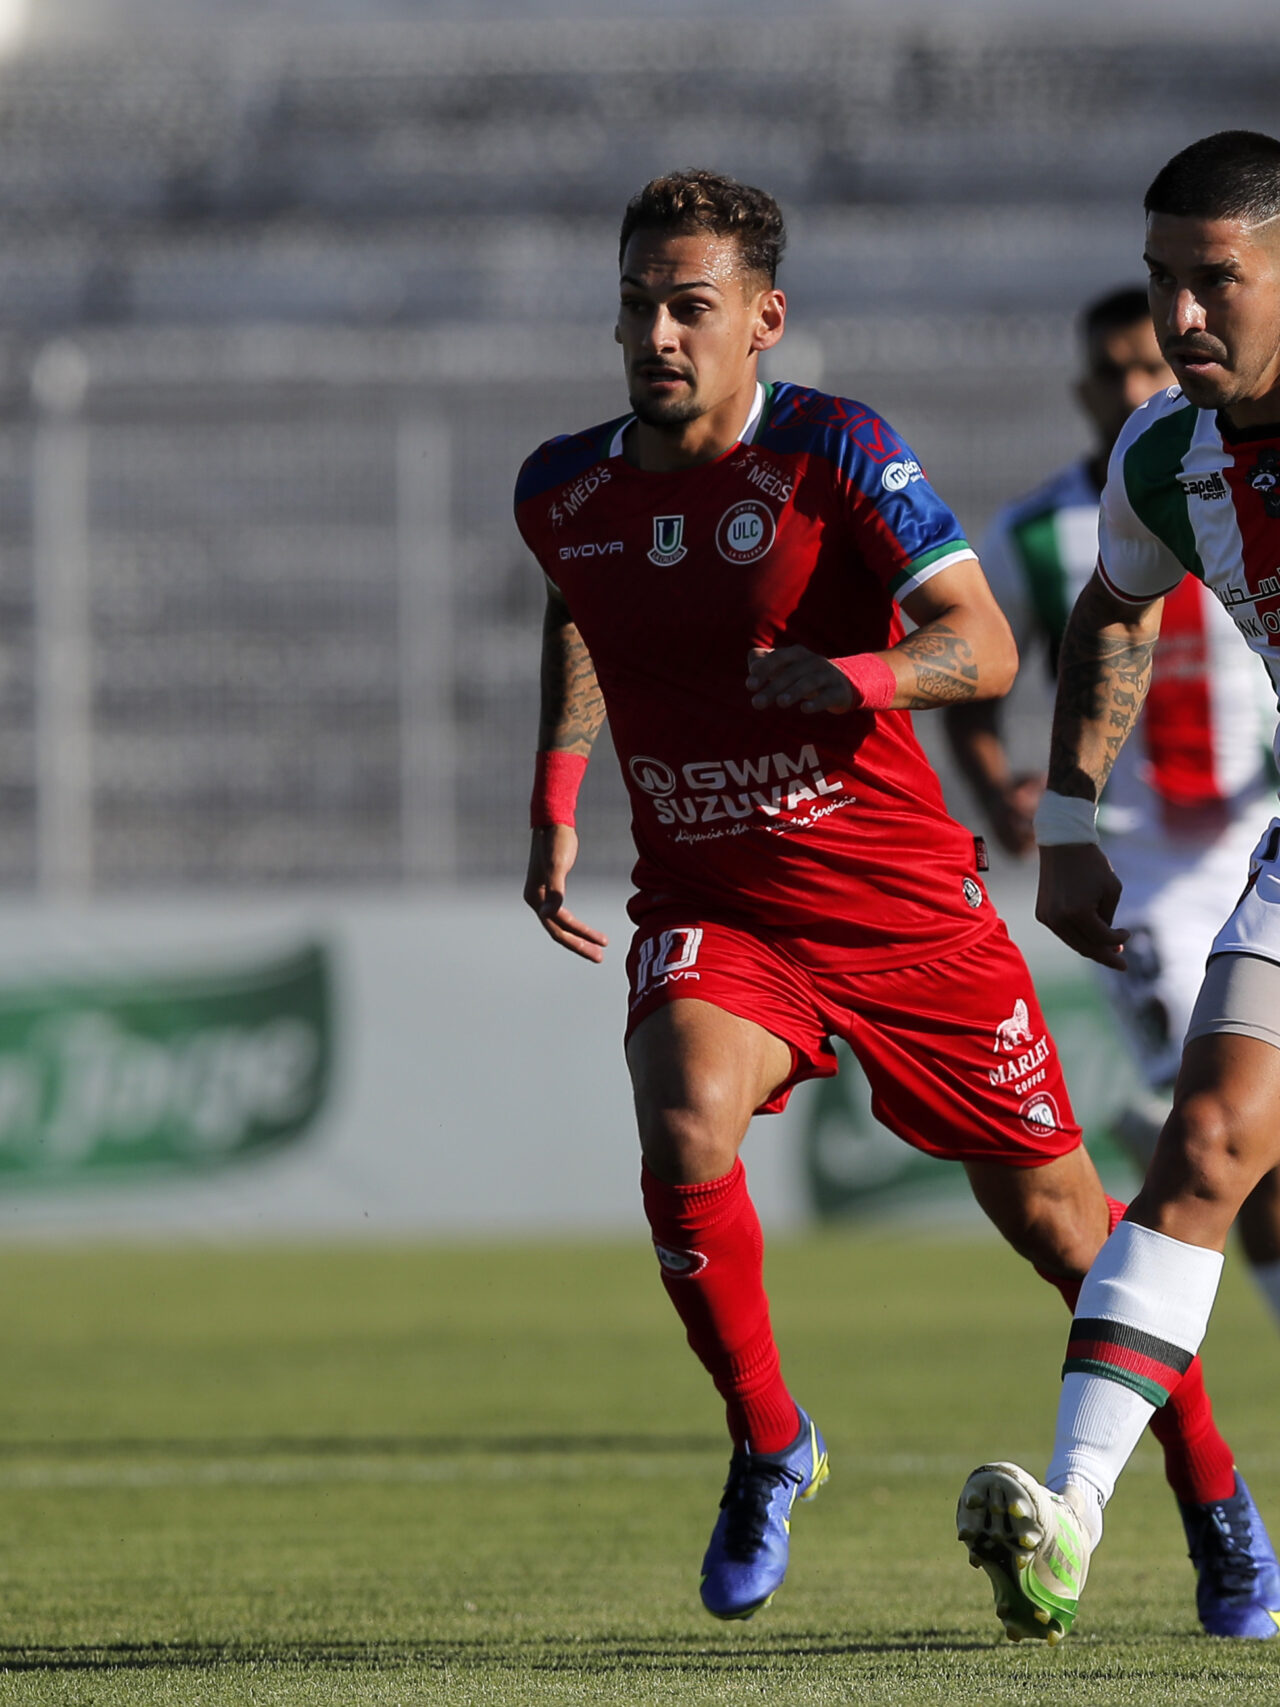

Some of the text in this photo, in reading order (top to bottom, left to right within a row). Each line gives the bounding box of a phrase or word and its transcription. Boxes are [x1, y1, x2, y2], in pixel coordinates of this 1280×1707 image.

[563, 468, 612, 516] MEDS
[747, 464, 793, 502] MEDS
[1183, 471, 1225, 499] capelli
[1202, 490, 1227, 501] SPORT
[733, 519, 759, 541] ULC
[559, 541, 623, 560] GIVOVA
[682, 744, 820, 790] GWM
[653, 770, 844, 825] SUZUVAL
[809, 796, 857, 824] Servicio
[637, 928, 703, 994] 10
[989, 1035, 1050, 1087] MARLEY
[1014, 1068, 1046, 1095] COFFEE
